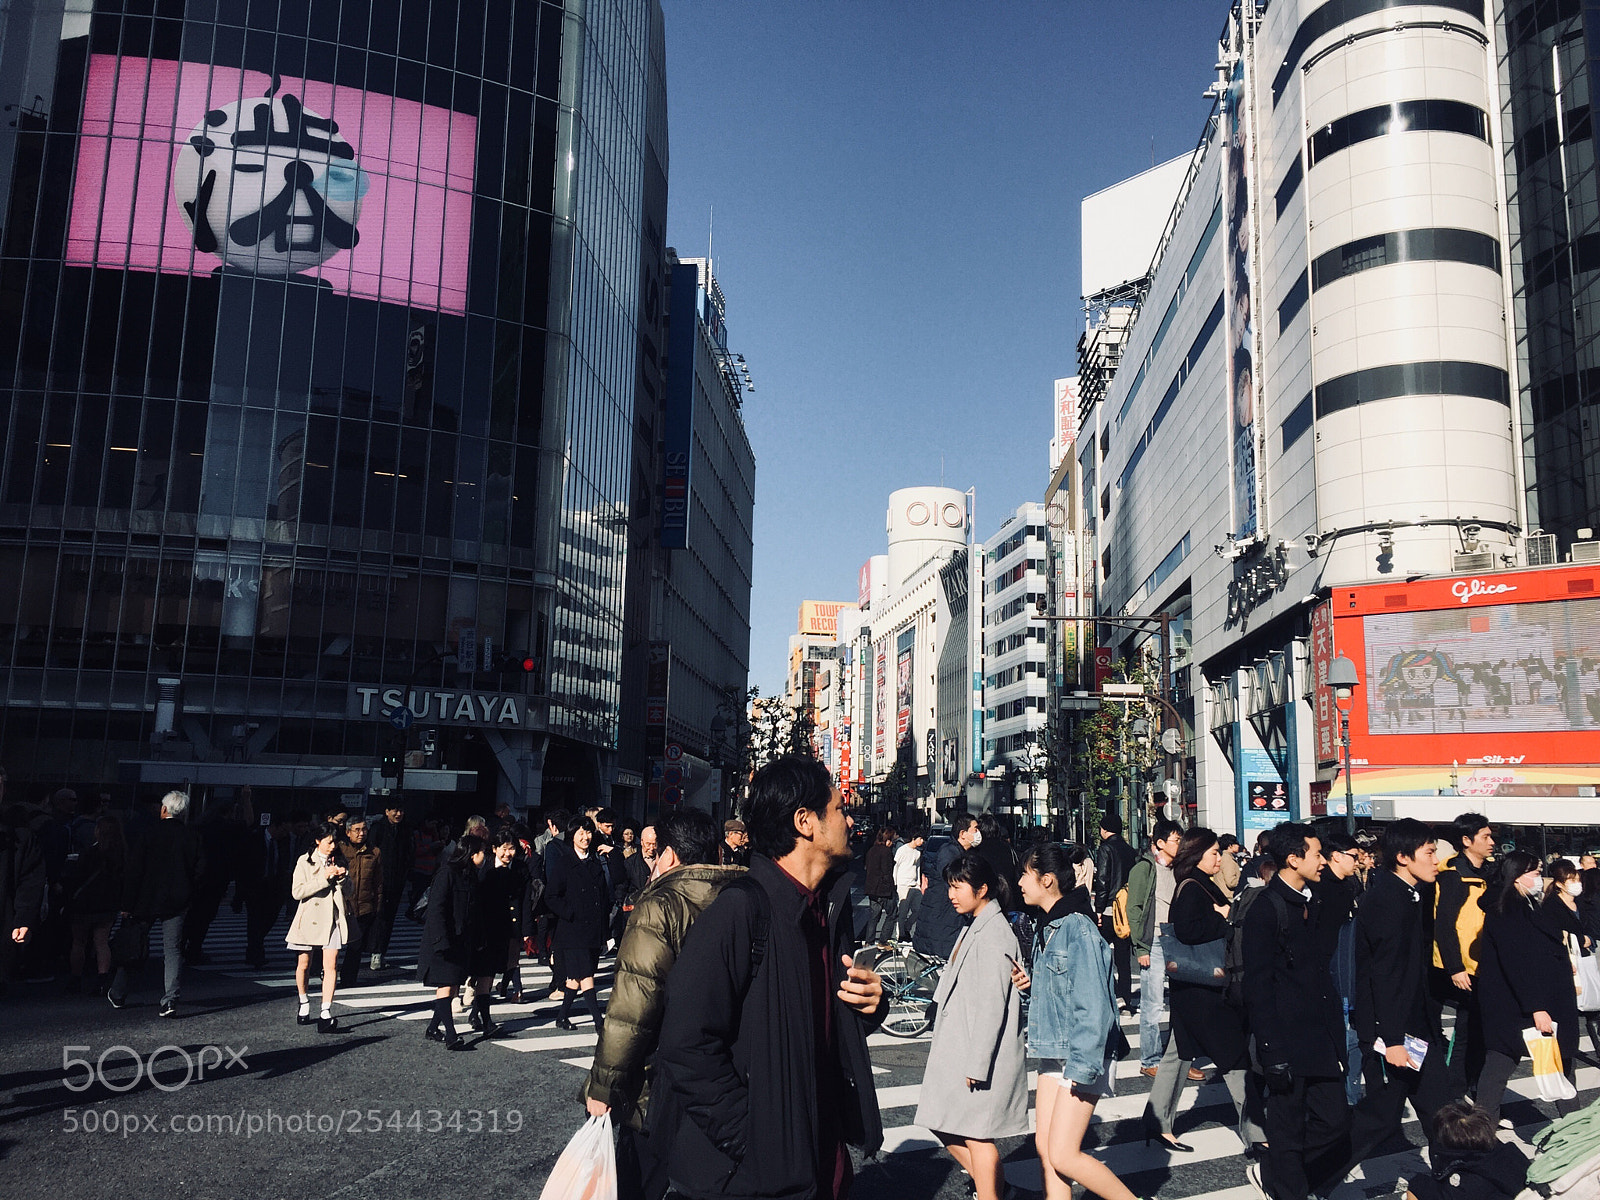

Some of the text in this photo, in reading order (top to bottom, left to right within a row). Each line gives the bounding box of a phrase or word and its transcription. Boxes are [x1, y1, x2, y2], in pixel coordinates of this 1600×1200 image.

[1060, 385, 1076, 447] 大和証券
[664, 451, 687, 530] SEIBU
[1451, 579, 1517, 603] Glico
[814, 604, 845, 617] TOWE
[356, 687, 520, 725] TSUTAYA
[1317, 627, 1332, 755] 天津甘栗
[1312, 790, 1330, 806] 天津甘
